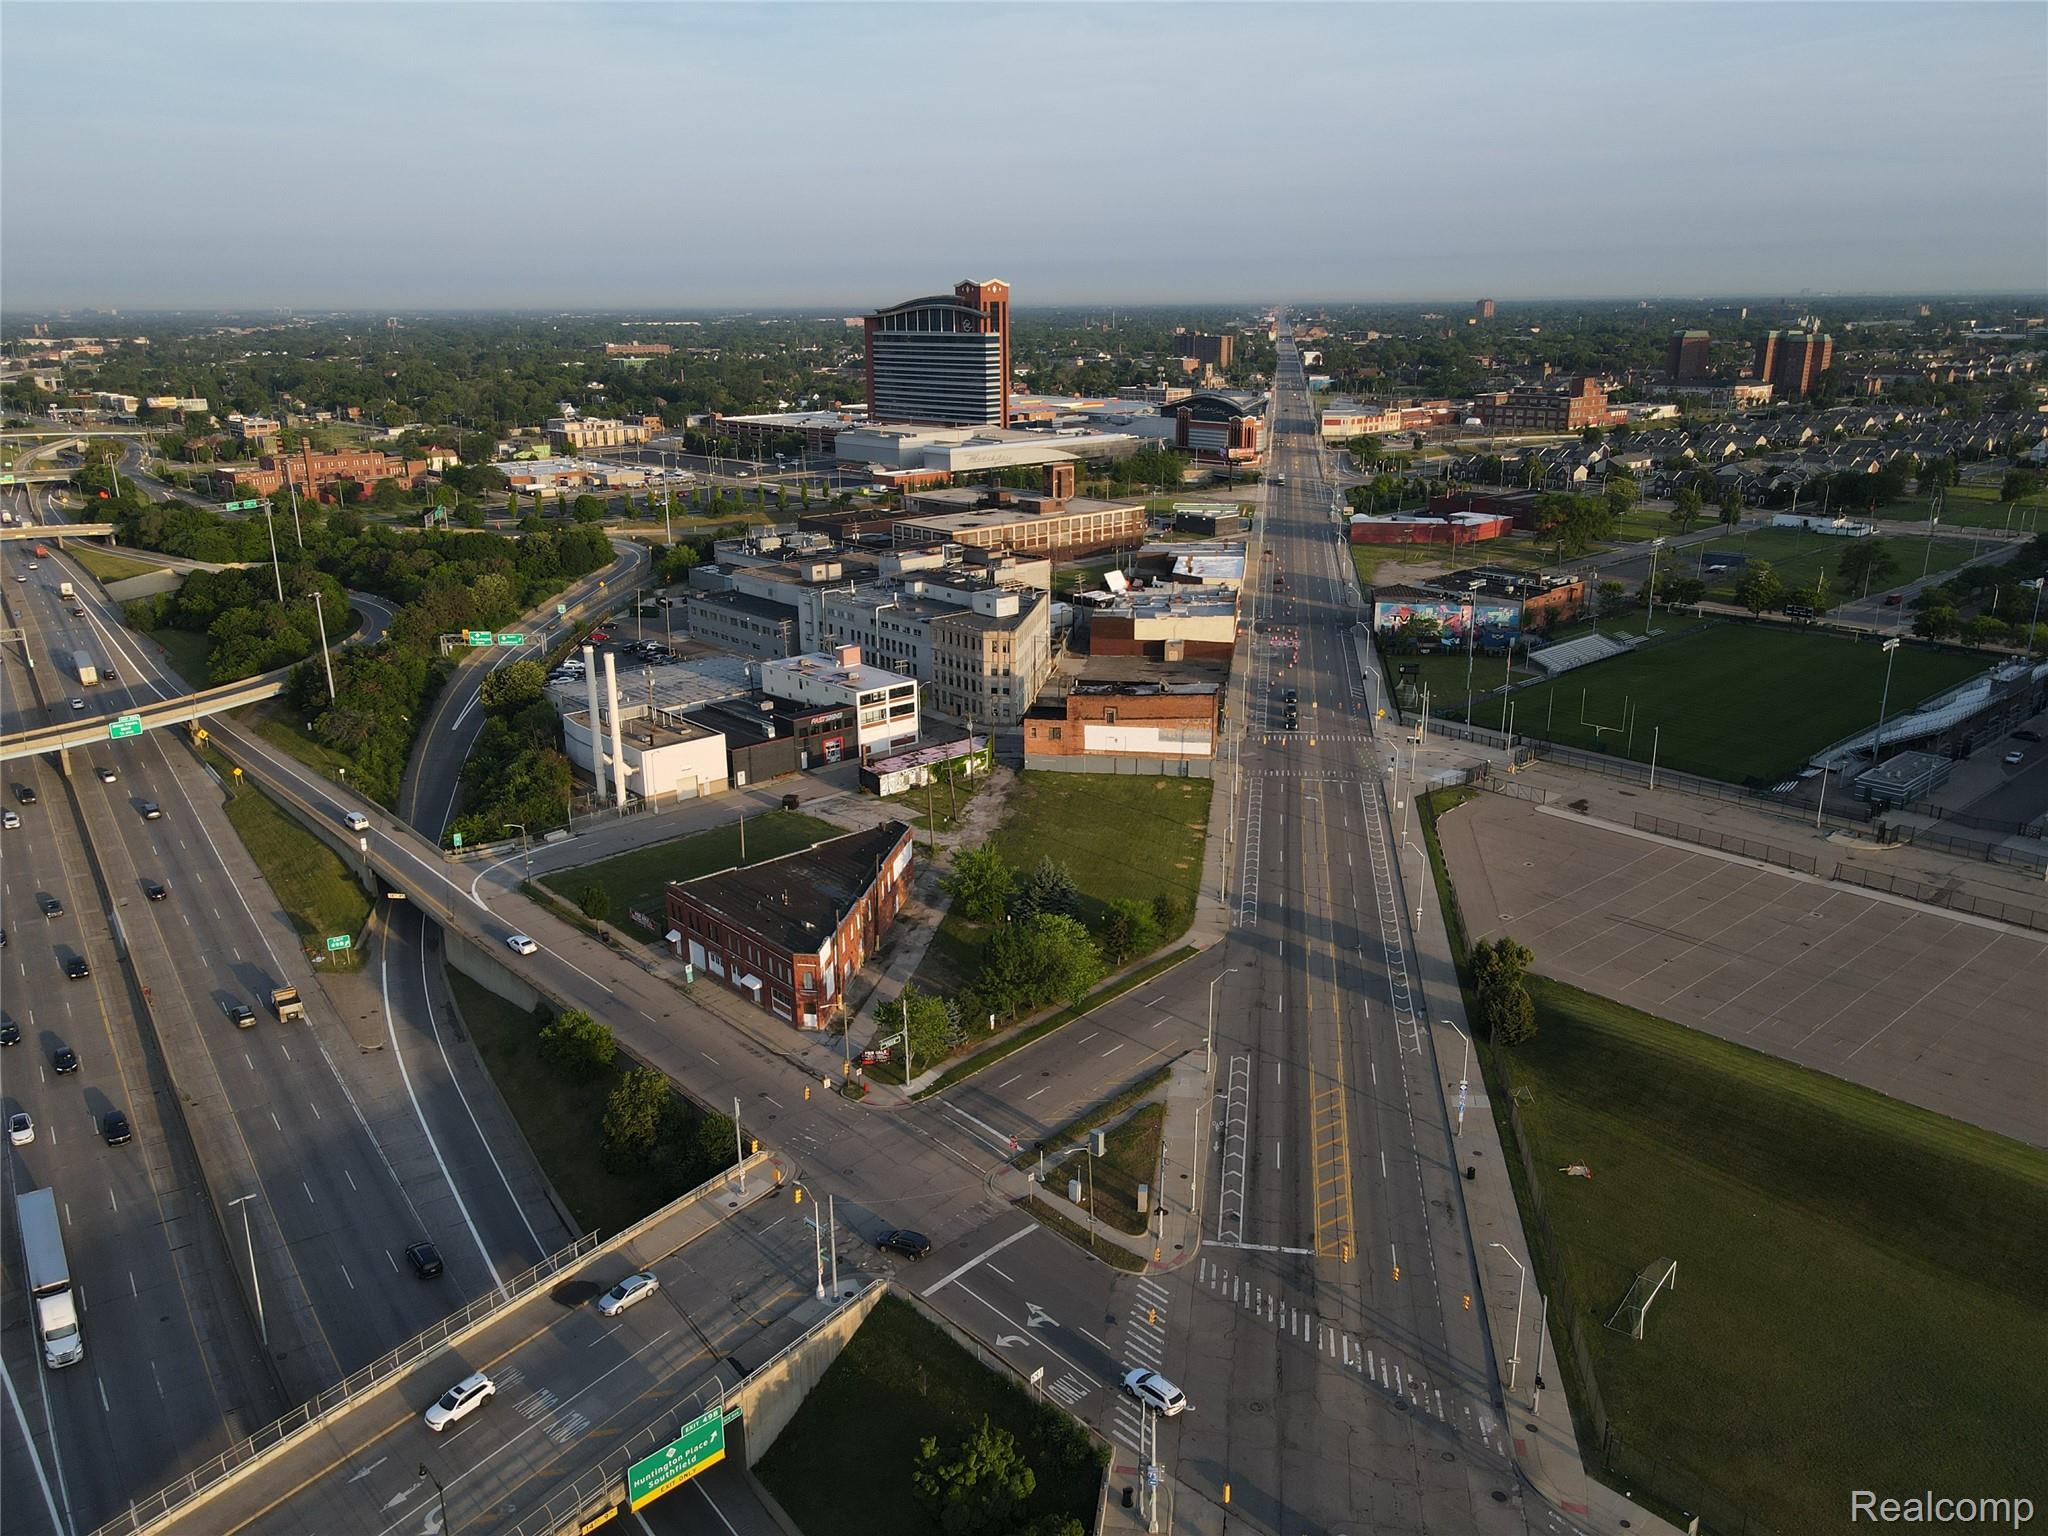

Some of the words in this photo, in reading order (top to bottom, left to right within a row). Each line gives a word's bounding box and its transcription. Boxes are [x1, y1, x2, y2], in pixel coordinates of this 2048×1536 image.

[1048, 1372, 1092, 1405] ONLY
[685, 1421, 700, 1433] EXIT
[703, 1409, 719, 1423] 49B
[633, 1455, 683, 1488] Huntington
[684, 1440, 709, 1457] Place
[648, 1455, 697, 1489] Southfield
[660, 1480, 676, 1493] EXIT
[678, 1468, 698, 1482] ONLY
